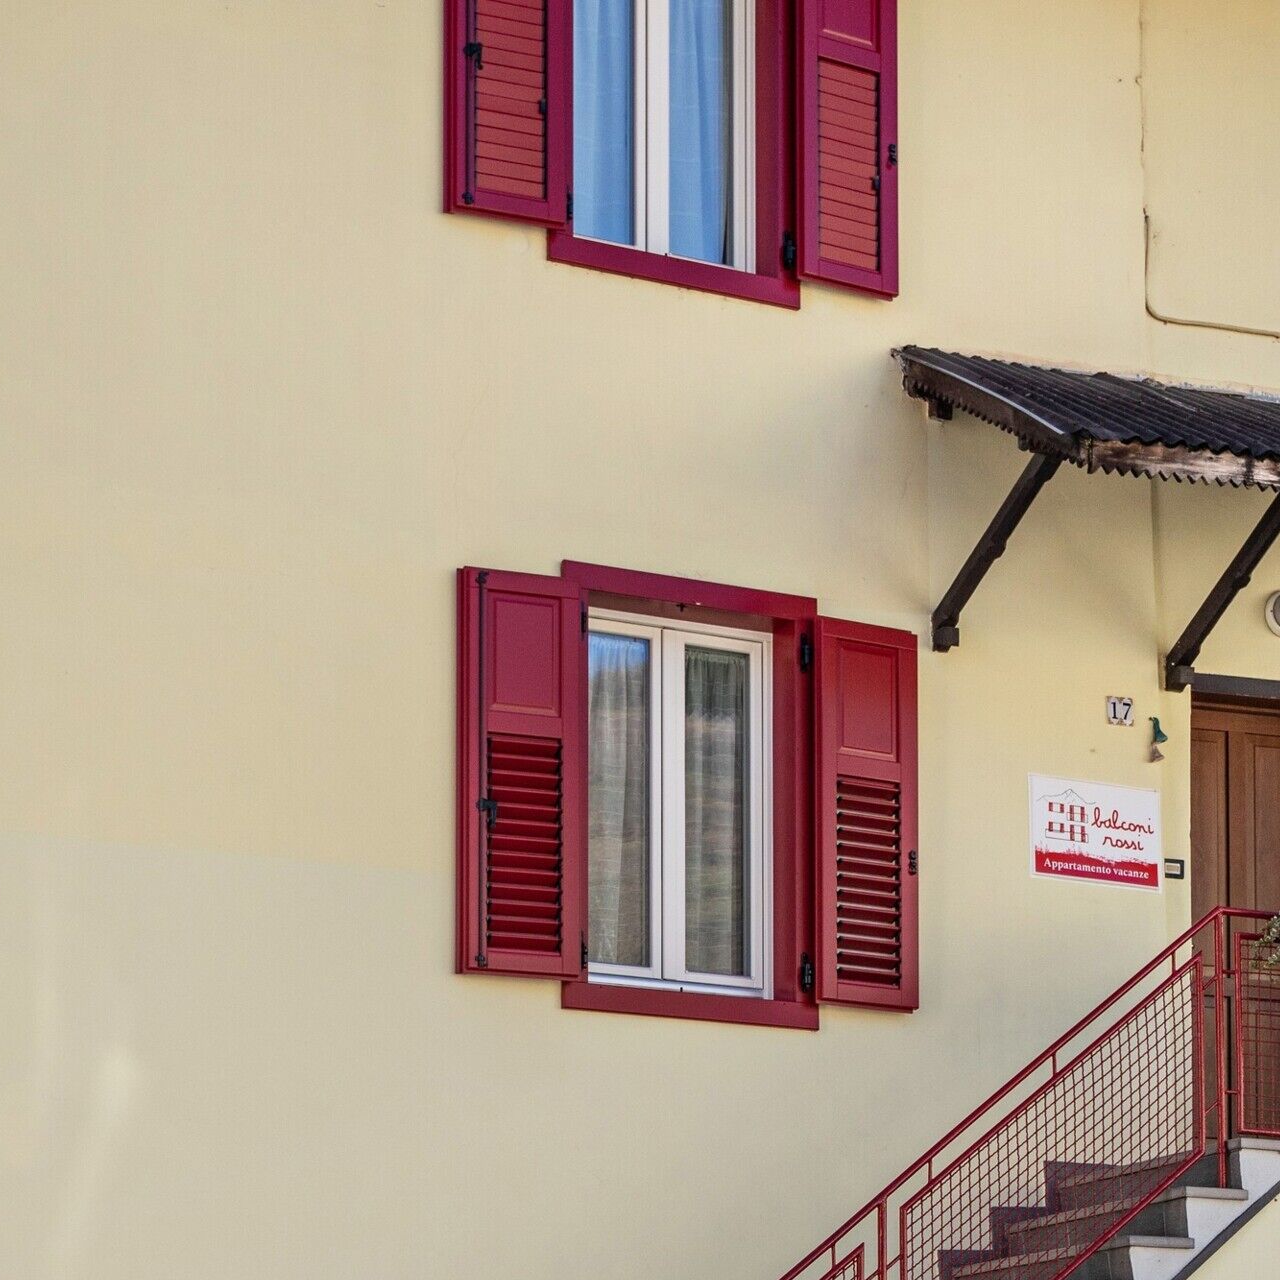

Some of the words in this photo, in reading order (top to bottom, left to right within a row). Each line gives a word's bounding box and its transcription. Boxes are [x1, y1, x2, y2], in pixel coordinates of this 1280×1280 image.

[1110, 701, 1132, 720] 17
[1091, 807, 1154, 834] balconi
[1102, 834, 1144, 850] rossi
[1043, 858, 1112, 875] Appartamento
[1112, 867, 1150, 879] vacanze
